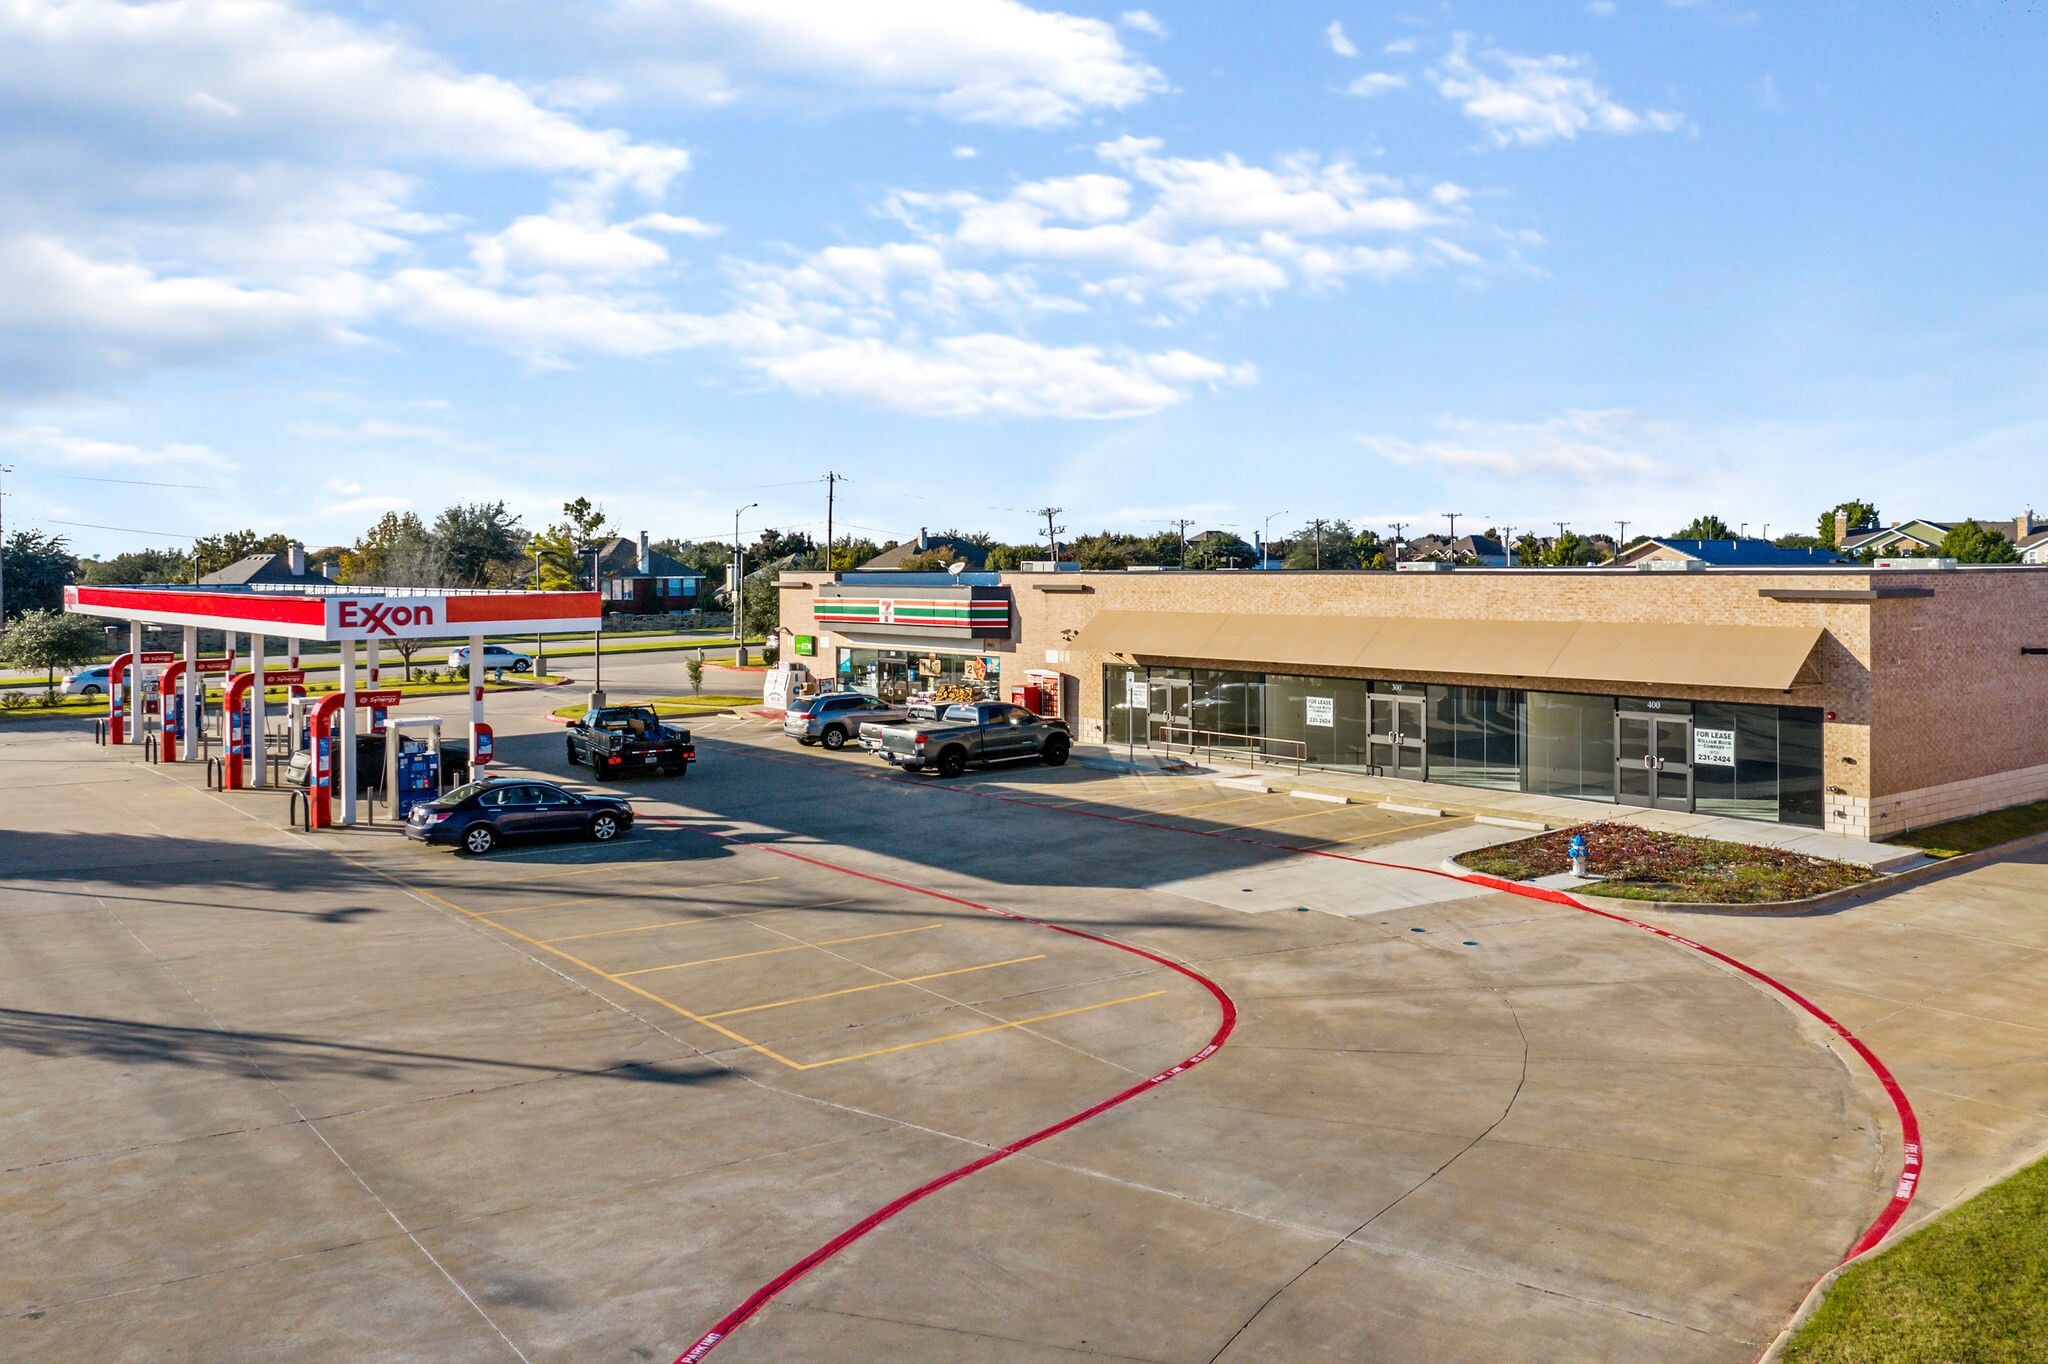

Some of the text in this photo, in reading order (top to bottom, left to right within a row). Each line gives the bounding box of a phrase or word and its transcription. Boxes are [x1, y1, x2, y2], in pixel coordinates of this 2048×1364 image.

[339, 601, 433, 636] Exxon
[967, 664, 973, 674] 2
[1391, 683, 1402, 691] 300
[369, 696, 397, 704] Synergy
[1647, 700, 1661, 709] 400
[1696, 730, 1732, 740] FOR LEASE
[681, 1332, 722, 1364] PARKING
